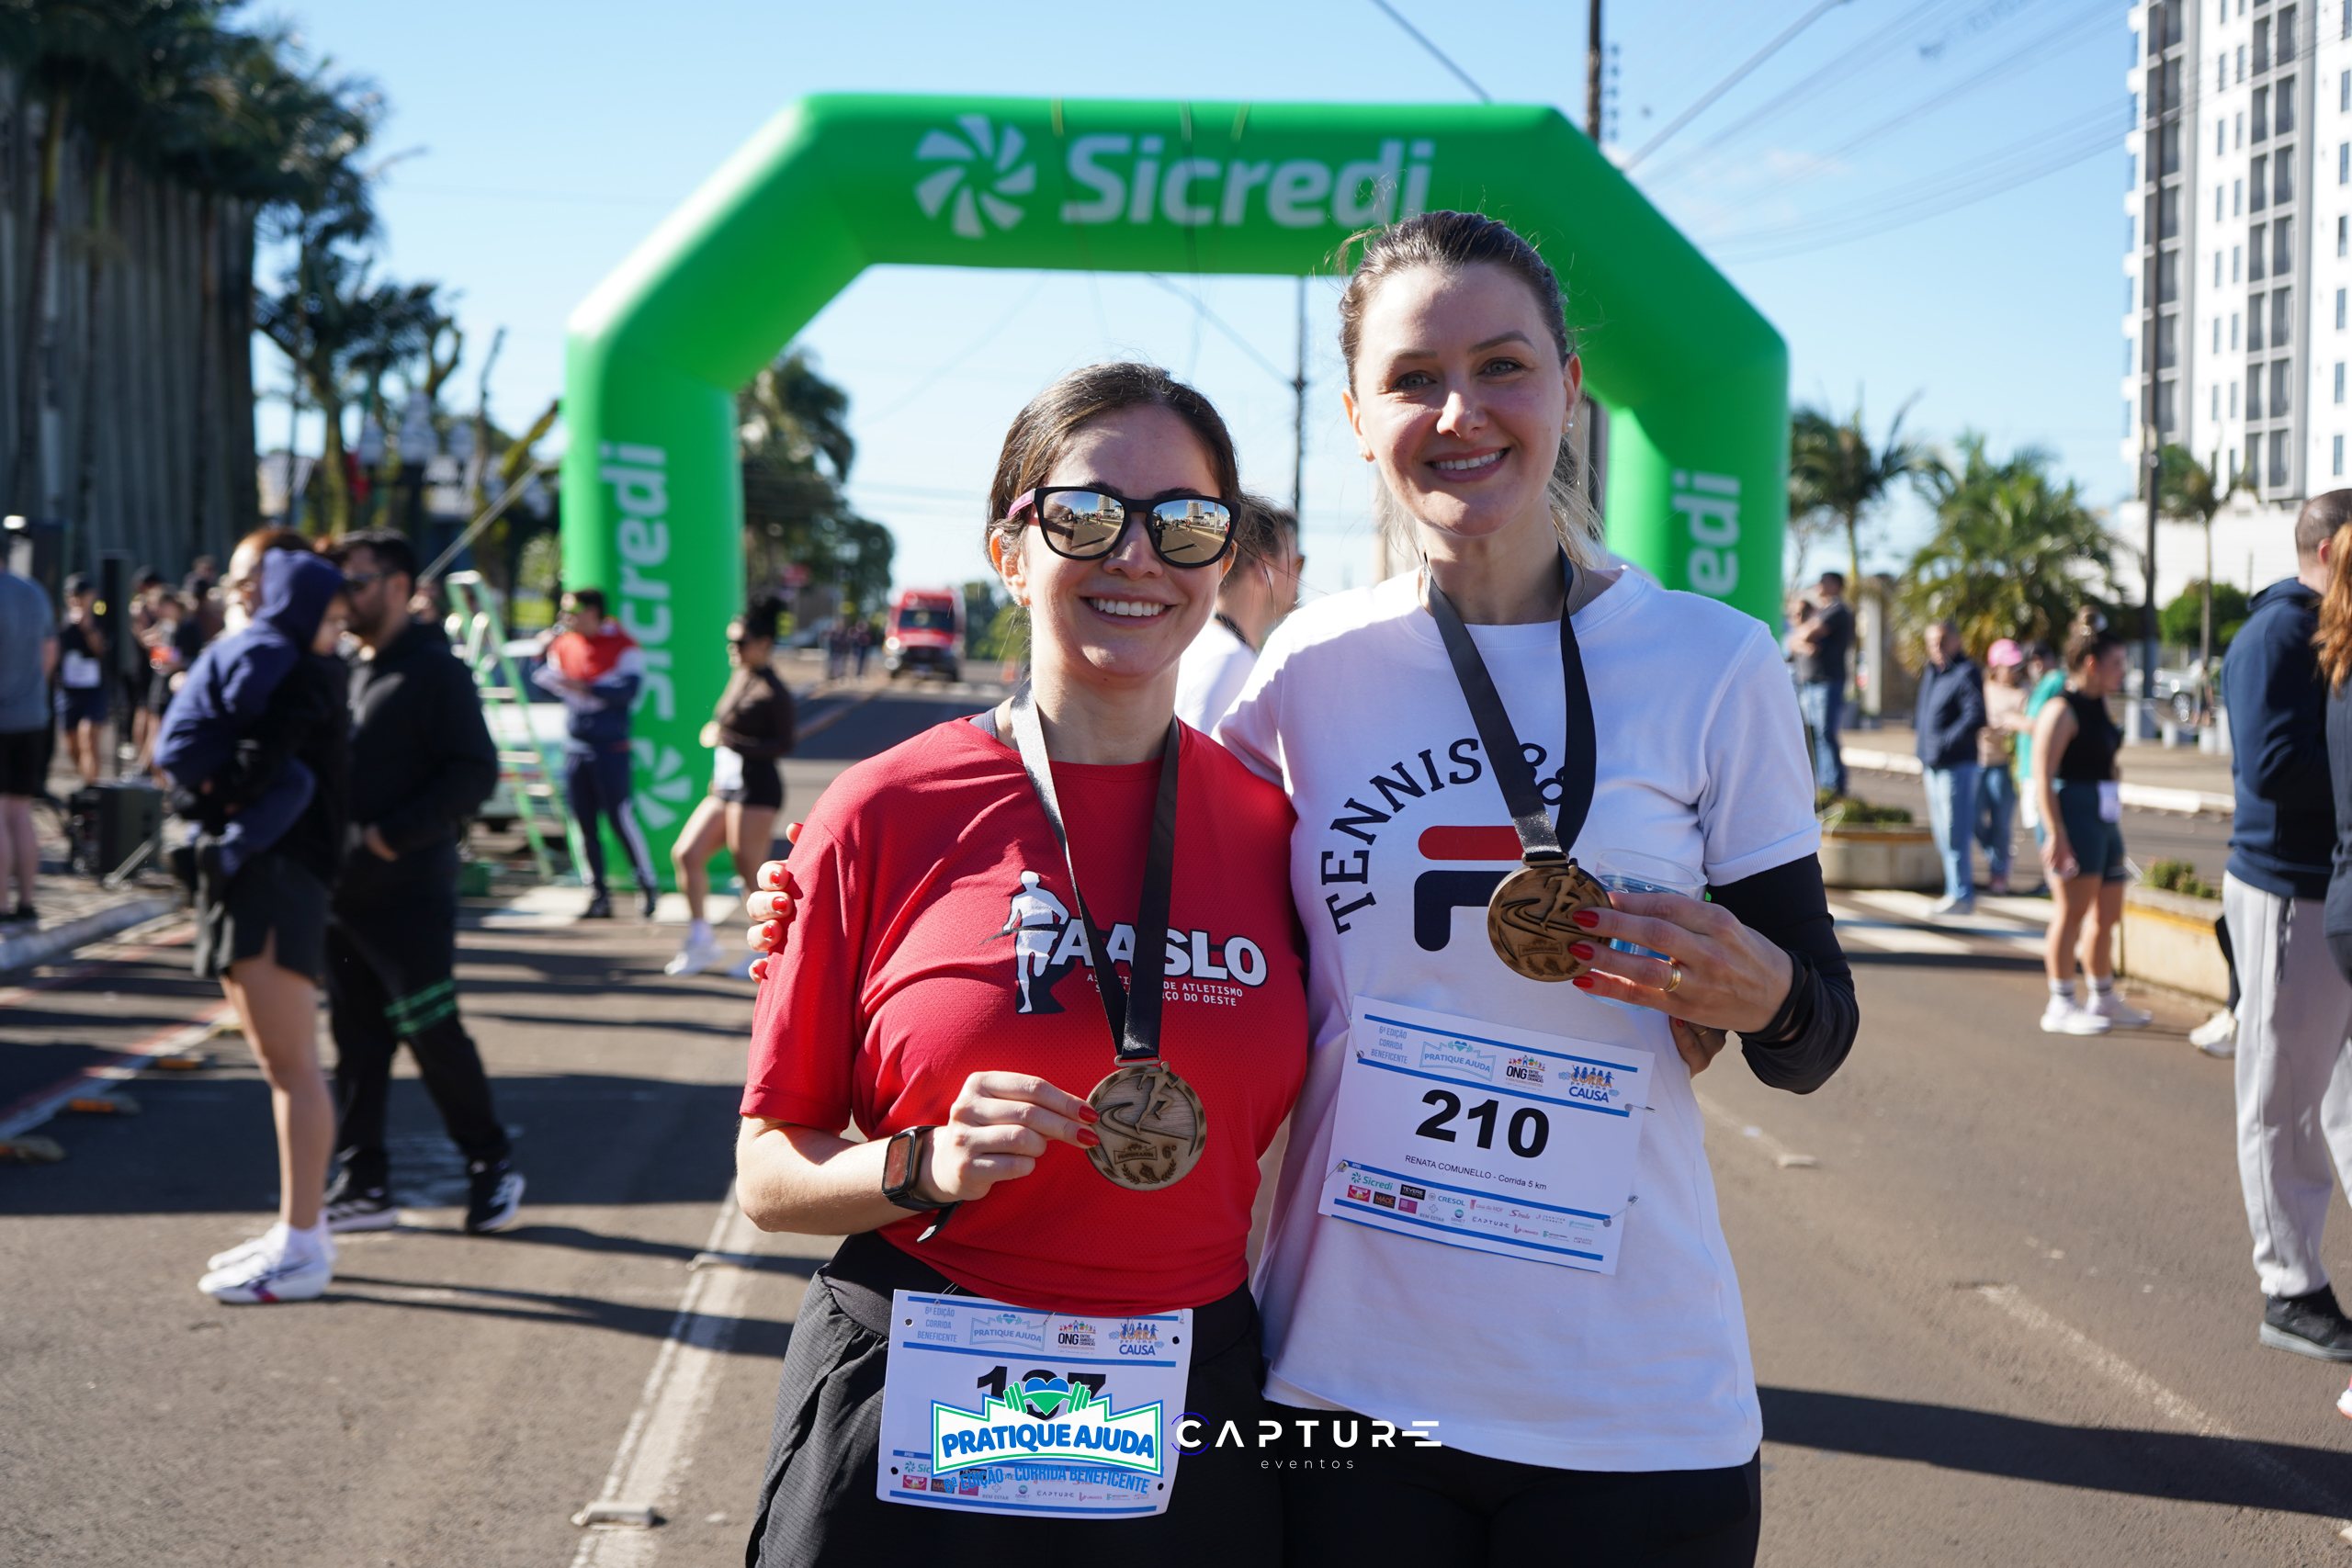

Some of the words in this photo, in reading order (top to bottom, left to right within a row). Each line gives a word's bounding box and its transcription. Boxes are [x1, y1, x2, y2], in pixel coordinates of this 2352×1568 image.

[1059, 133, 1435, 228] Sicredi
[1321, 739, 1482, 935] TENNIS
[1182, 983, 1243, 998] ATLETISMO
[1184, 993, 1198, 1002] DO
[1203, 995, 1238, 1007] OESTE
[1386, 1027, 1408, 1040] EDIÇÃO
[1378, 1038, 1403, 1051] CORRIDA
[1371, 1048, 1408, 1064] BENEFICENTE
[1424, 1053, 1464, 1064] PRATIQUE
[1464, 1059, 1490, 1073] AJUDA
[1506, 1066, 1528, 1079] ONG
[1568, 1086, 1610, 1103] CAUSA
[1415, 1089, 1550, 1159] 210
[1405, 1155, 1436, 1169] RENATA
[1438, 1162, 1492, 1179] COMUNELLO
[1498, 1174, 1526, 1187] Corrida
[1534, 1181, 1547, 1190] km
[1363, 1176, 1394, 1191] Sicredi
[1402, 1185, 1424, 1196] TEVERE
[1438, 1195, 1465, 1206] CRESOL
[1430, 1214, 1445, 1223] ESTAR
[1472, 1215, 1510, 1229] CAPTURE
[933, 1306, 956, 1318] EDIÇÃO
[925, 1319, 952, 1329] CORRIDA
[917, 1330, 957, 1342] BENEFICENTE
[974, 1328, 1014, 1337] PRATIQUE
[1015, 1332, 1042, 1342] AJUDA
[1057, 1332, 1080, 1345] ONG
[1118, 1344, 1156, 1356] CAUSA
[1036, 1490, 1074, 1498] CAPTURE
